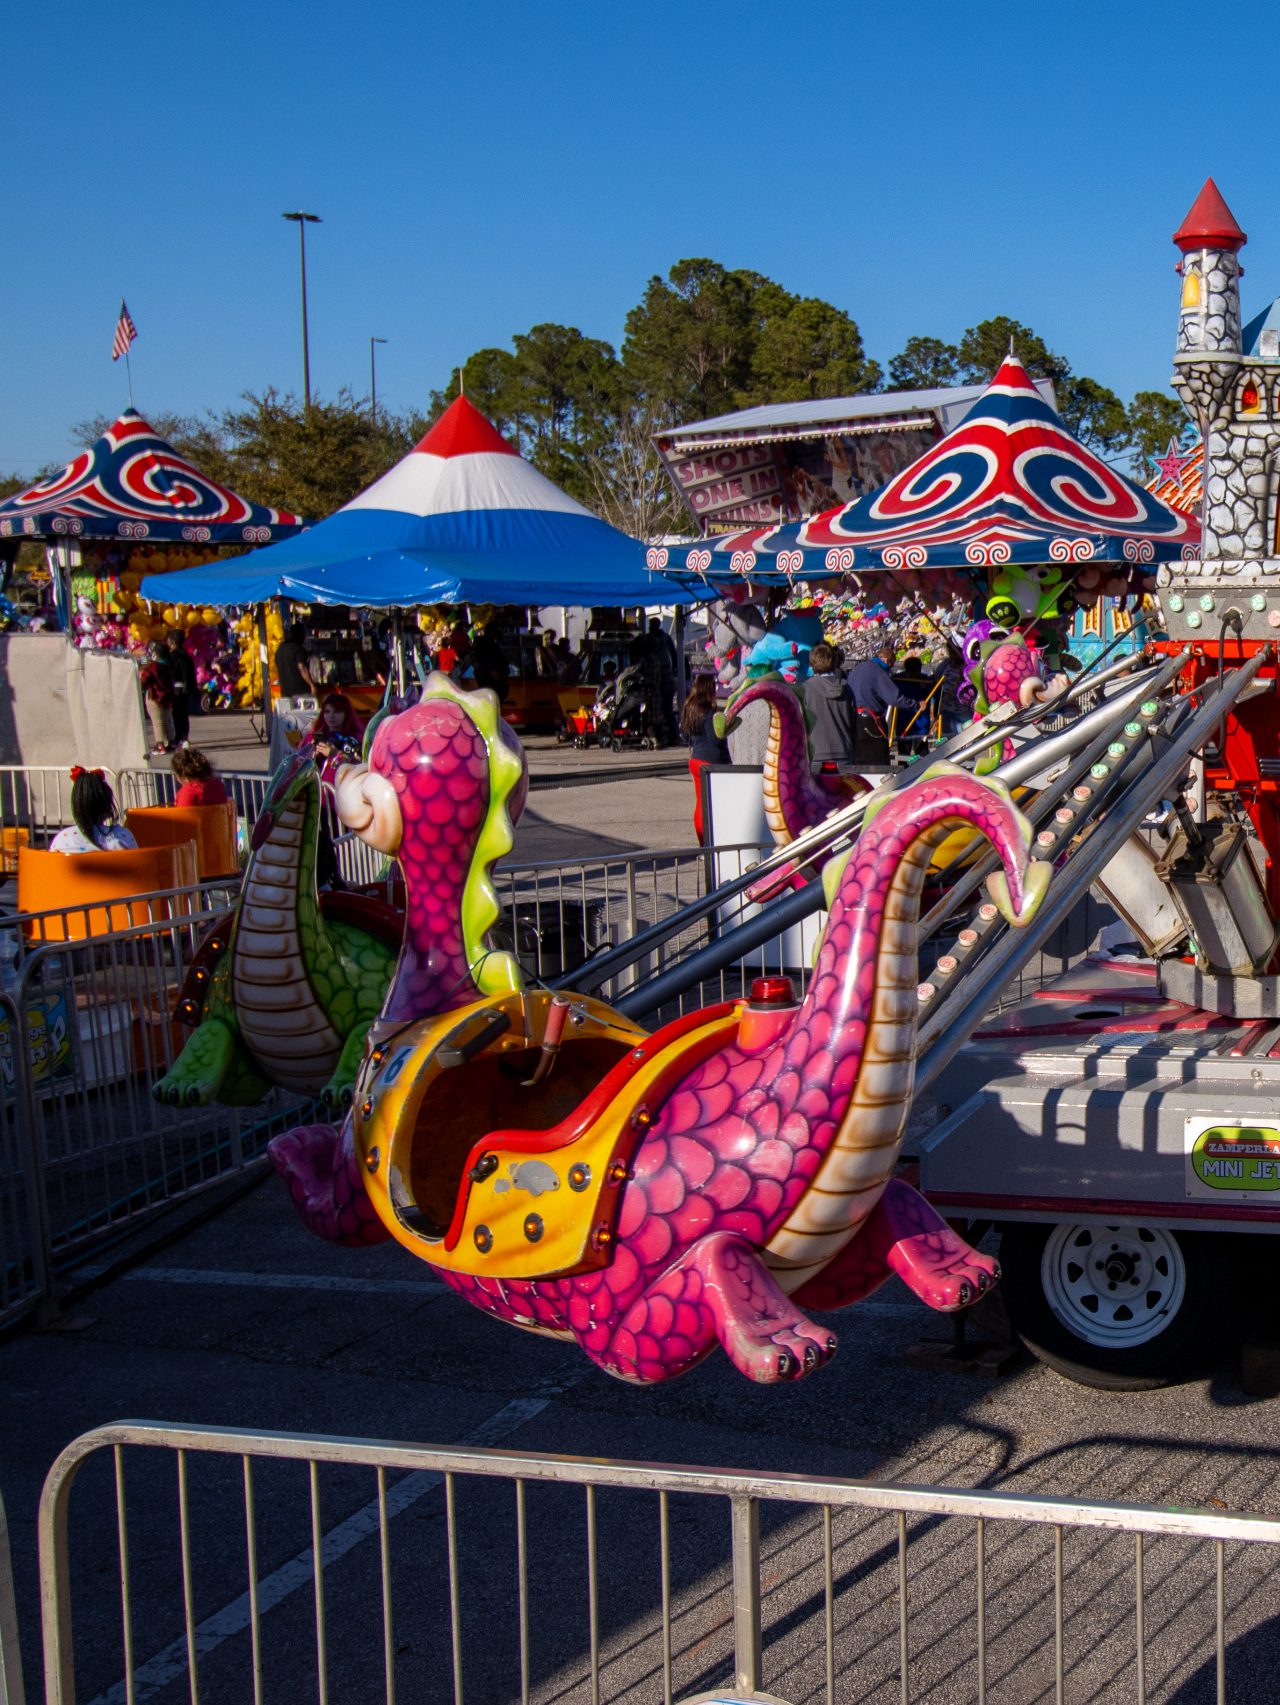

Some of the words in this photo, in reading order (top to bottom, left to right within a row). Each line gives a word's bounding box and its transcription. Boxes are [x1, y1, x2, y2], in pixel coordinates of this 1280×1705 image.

[679, 446, 770, 483] SHOTS
[690, 476, 745, 510] ONE
[750, 469, 778, 491] IN
[384, 1048, 412, 1084] 6
[1208, 1142, 1280, 1155] ZAMPERLA
[1202, 1159, 1244, 1179] MINI
